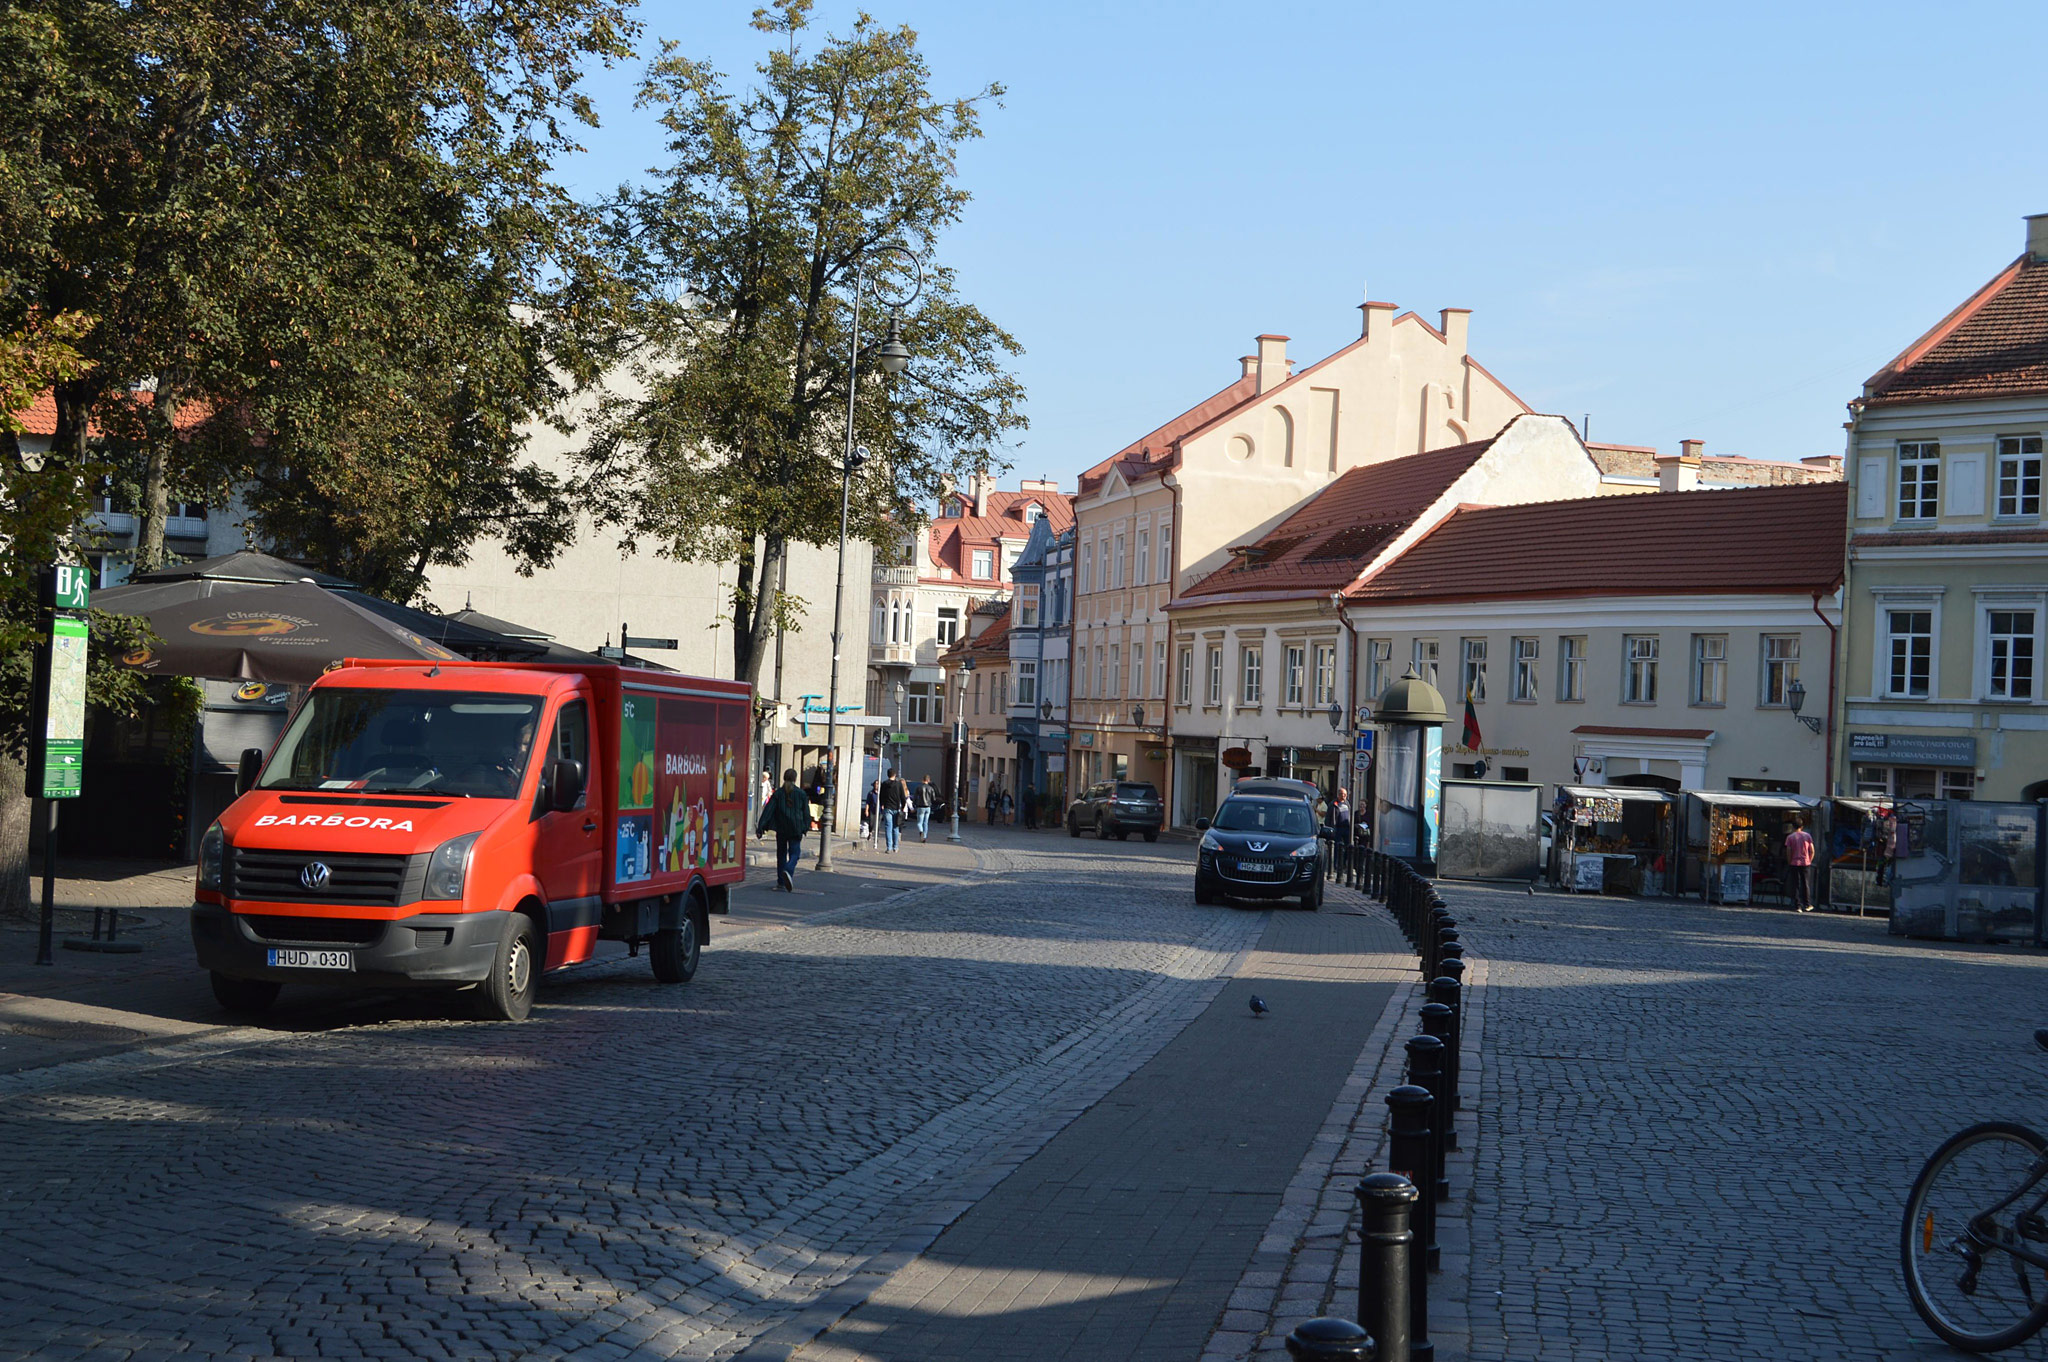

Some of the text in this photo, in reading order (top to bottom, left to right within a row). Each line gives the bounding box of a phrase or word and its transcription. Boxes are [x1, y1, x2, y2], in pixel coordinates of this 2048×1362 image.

[665, 753, 707, 775] BARBORA
[254, 814, 413, 832] BARBORA
[276, 950, 309, 966] HUD
[319, 952, 348, 967] 030
